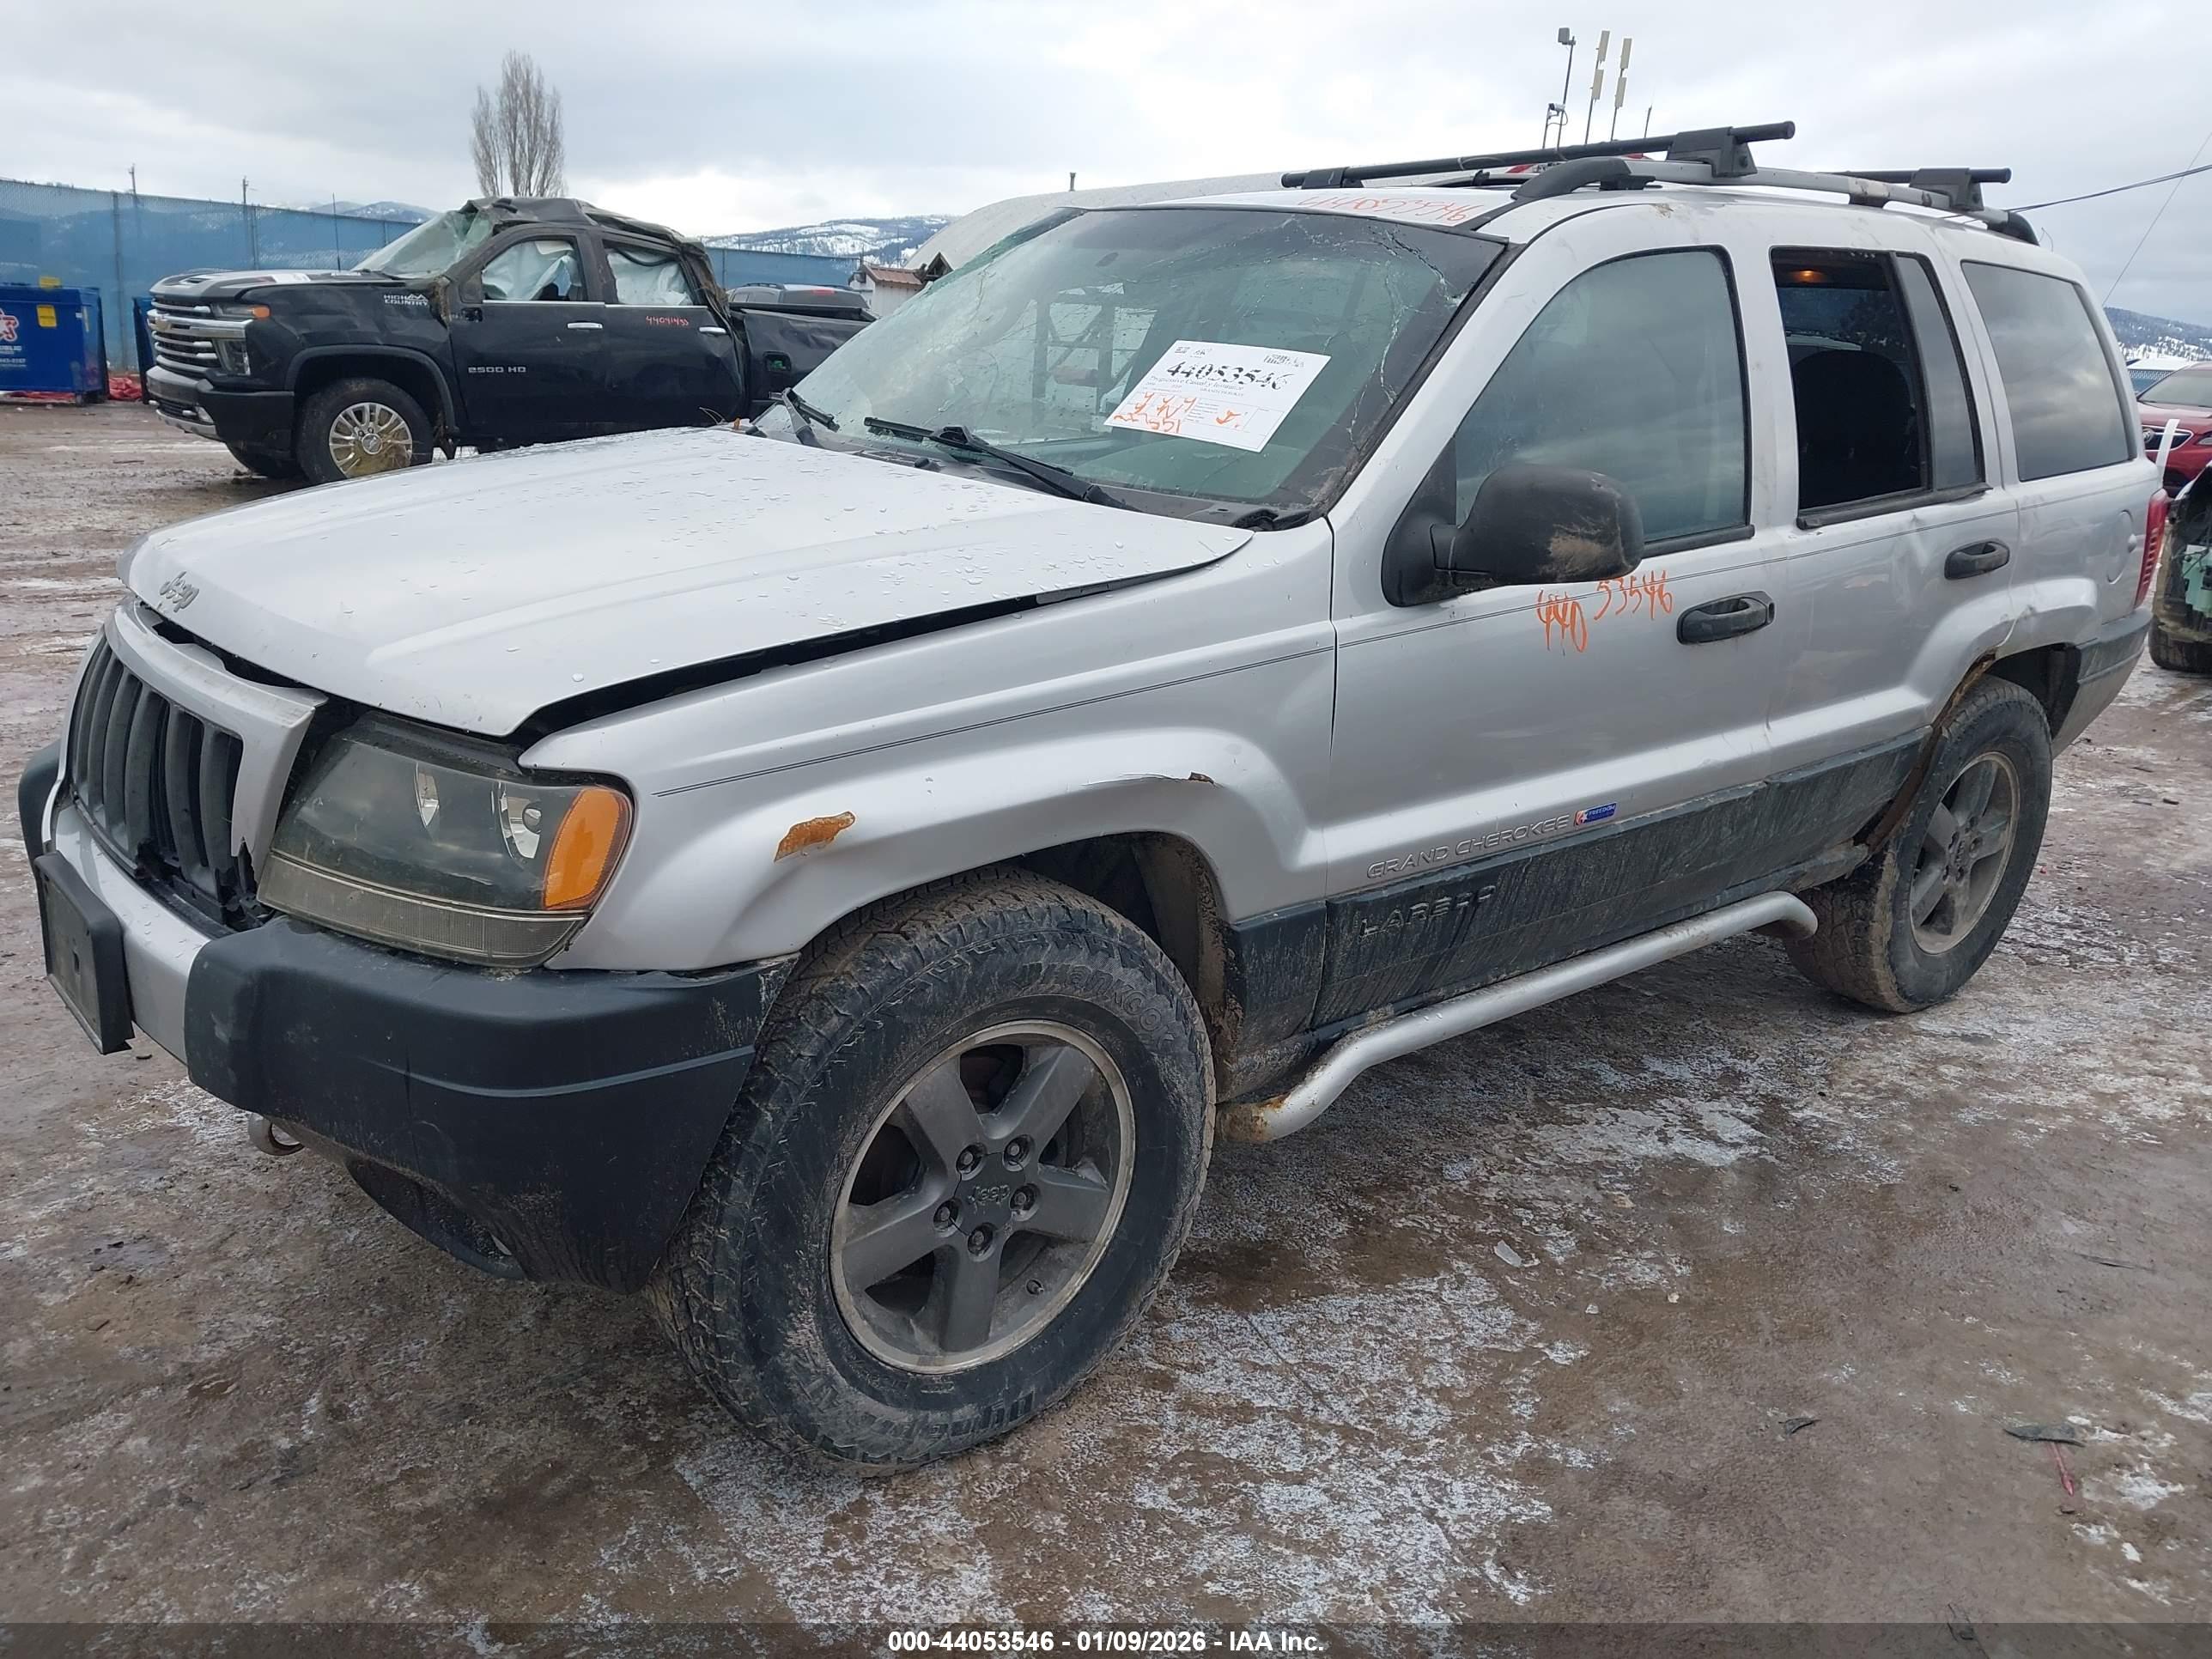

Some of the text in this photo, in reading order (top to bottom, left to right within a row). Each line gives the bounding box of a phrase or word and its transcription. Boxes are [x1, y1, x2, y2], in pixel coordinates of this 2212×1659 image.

[1167, 361, 1294, 391] 44053546
[1594, 569, 1673, 621] 53546
[1366, 814, 1571, 879] GRAND CHEROKEE
